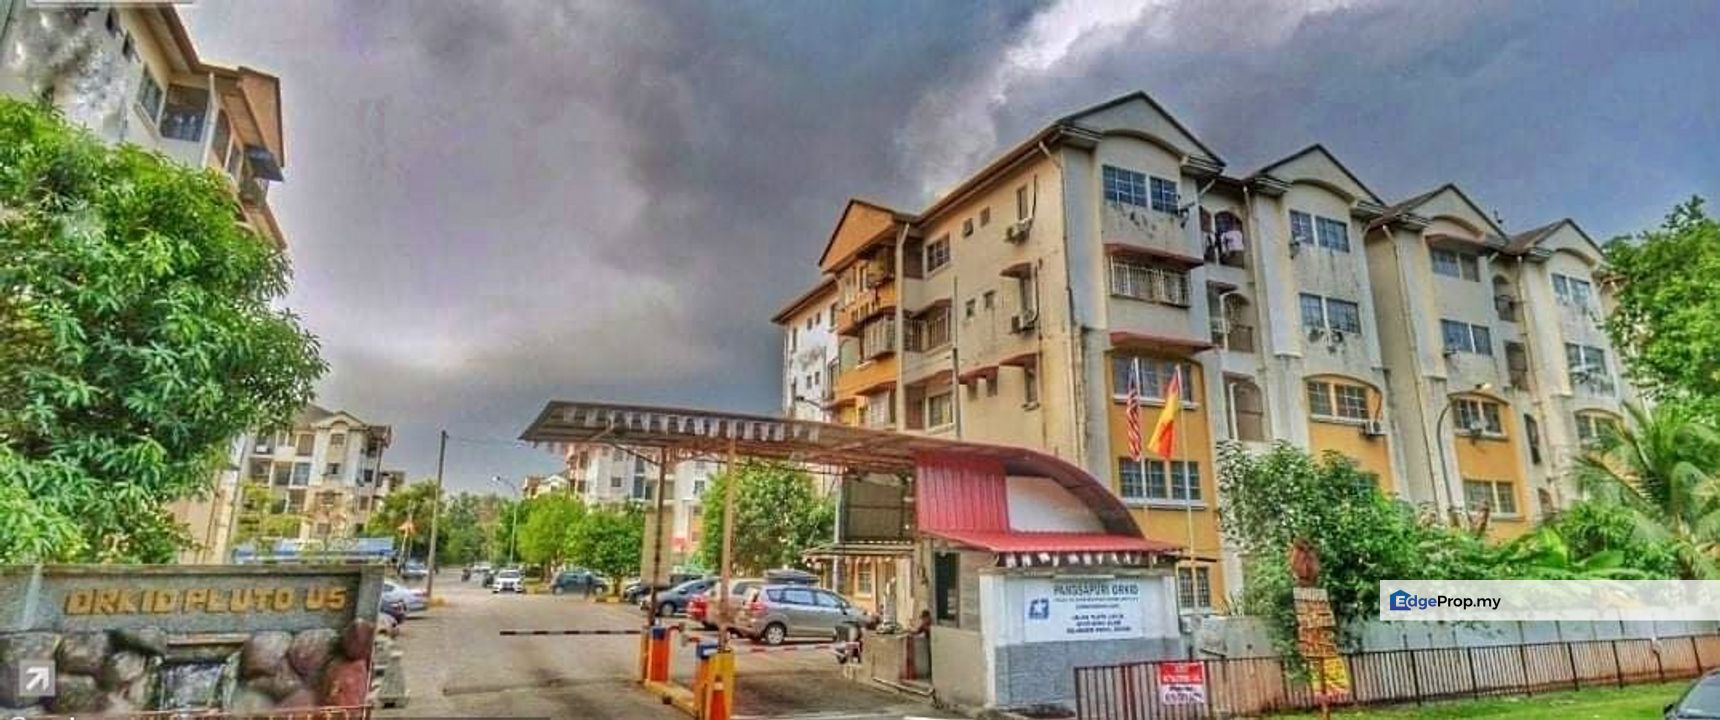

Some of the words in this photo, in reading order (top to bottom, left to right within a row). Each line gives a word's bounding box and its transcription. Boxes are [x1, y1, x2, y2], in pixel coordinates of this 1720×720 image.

[1112, 584, 1138, 595] ORKID
[65, 588, 179, 614] ORKID
[183, 587, 295, 613] PLUTO
